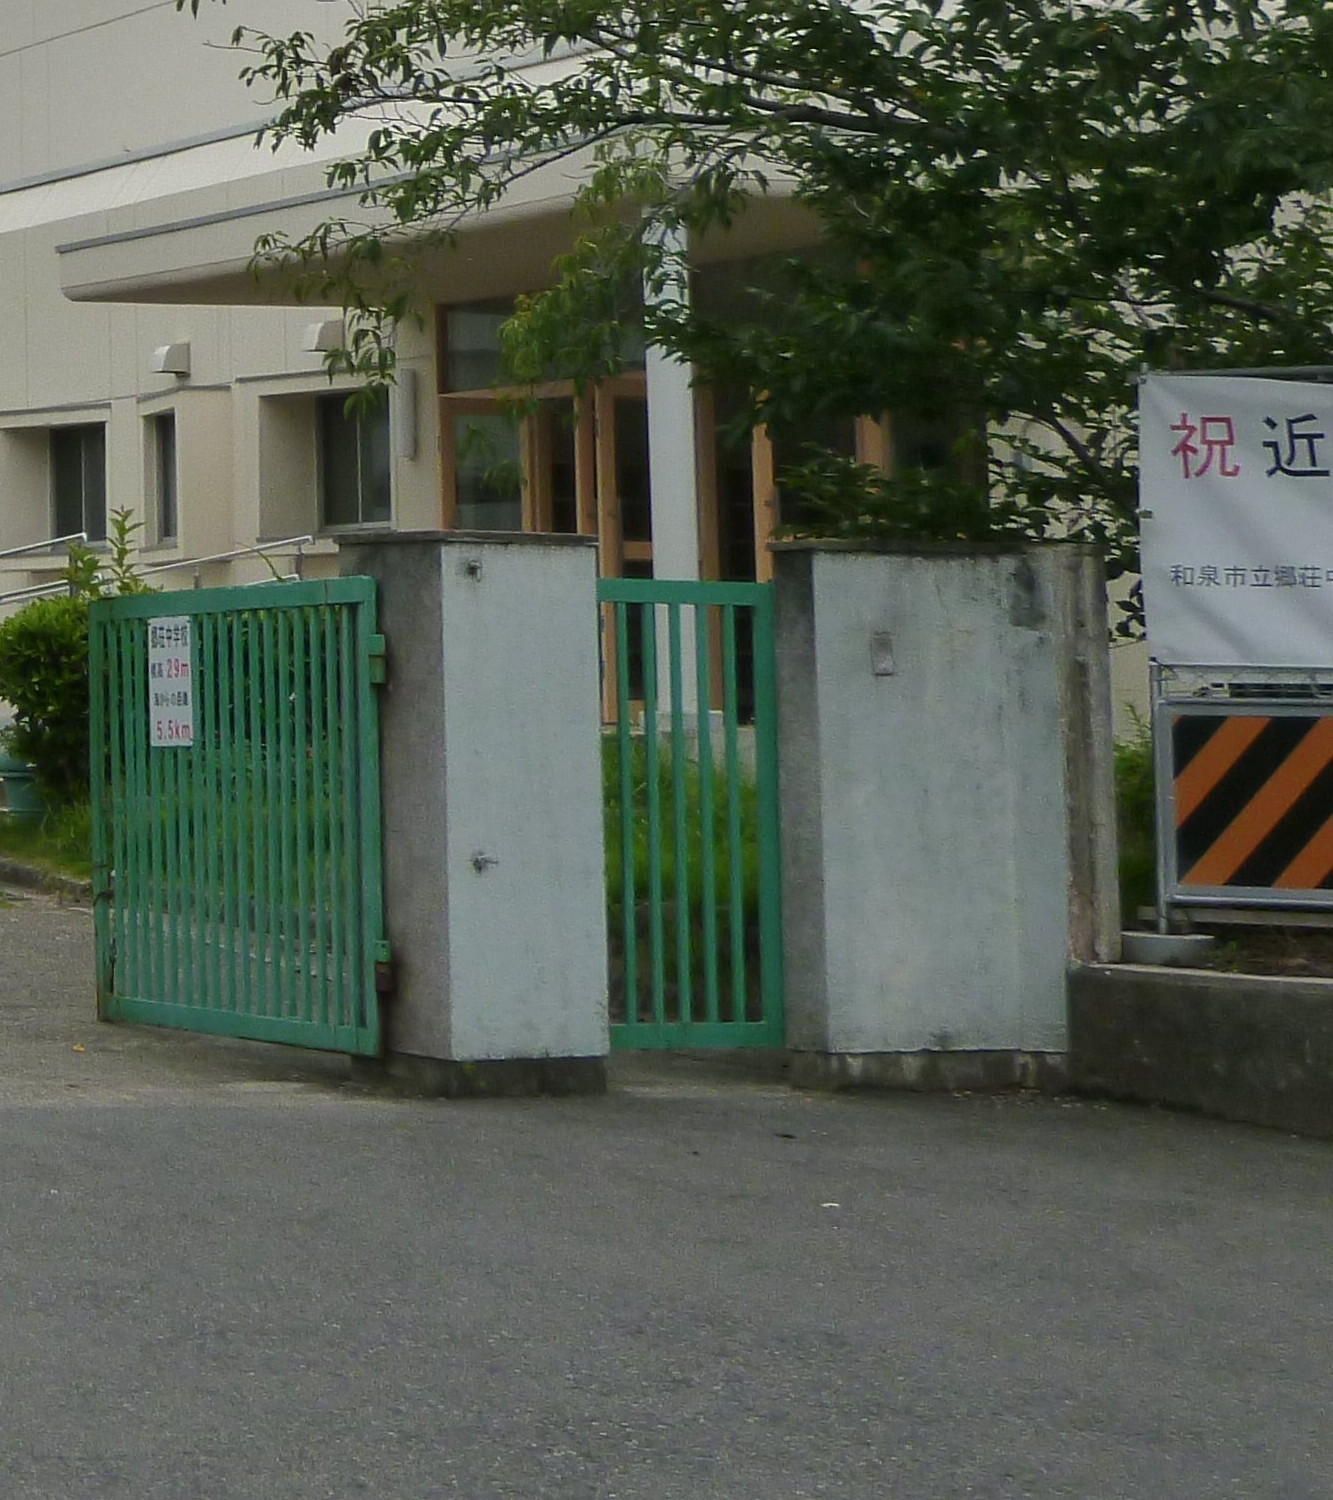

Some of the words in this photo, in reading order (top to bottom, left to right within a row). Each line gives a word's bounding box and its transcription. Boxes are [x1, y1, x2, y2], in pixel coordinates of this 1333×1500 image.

[1169, 412, 1240, 479] 祝
[1262, 413, 1330, 478] 近
[166, 658, 189, 679] 29m
[157, 719, 191, 740] 5.5km
